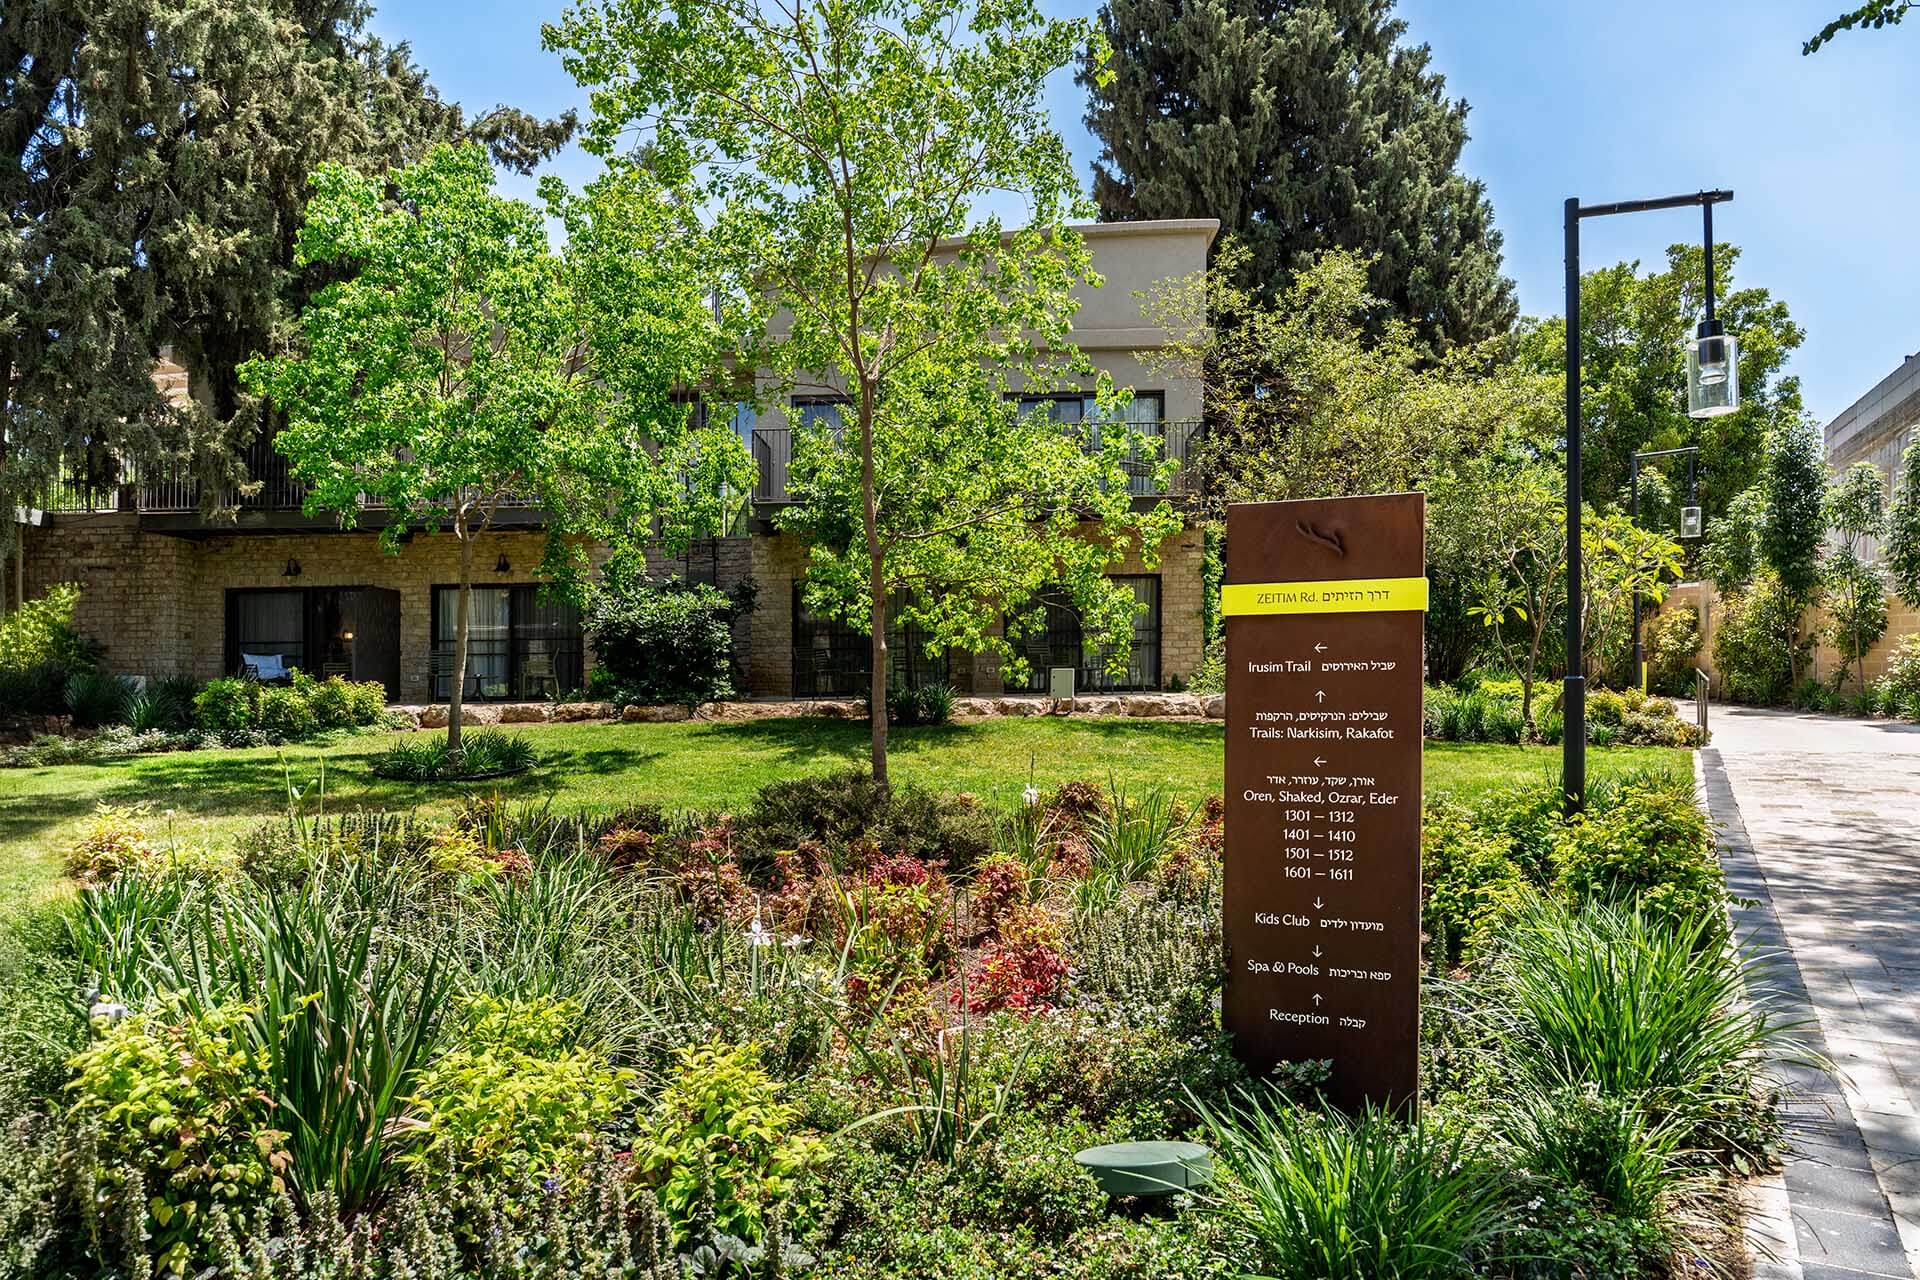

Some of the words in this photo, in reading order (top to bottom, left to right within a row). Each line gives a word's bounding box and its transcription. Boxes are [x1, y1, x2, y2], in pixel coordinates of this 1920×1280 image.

[1257, 593, 1297, 604] ZEITIM
[1300, 592, 1318, 602] Rd.
[1322, 591, 1363, 602] הזיתים
[1366, 590, 1390, 602] דרך
[1248, 661, 1283, 673] Irusim
[1286, 660, 1311, 673] Trail
[1321, 661, 1368, 672] האירוסים
[1370, 659, 1396, 671] שביל
[1255, 711, 1293, 722] הרקפות
[1349, 711, 1389, 721] שבילים:
[1250, 727, 1284, 739] Trails:
[1287, 727, 1343, 740] Narkisim,
[1346, 727, 1394, 739] Rakafot
[1266, 775, 1286, 785] אדר
[1321, 776, 1347, 787] שקד,
[1349, 777, 1375, 787] אורן,
[1243, 790, 1275, 803] Oren,
[1279, 790, 1325, 804] Shaked,
[1328, 792, 1366, 805] Ozrar,
[1369, 792, 1398, 805] Eder
[1285, 809, 1310, 821] 1301
[1329, 810, 1355, 822] 1312
[1283, 828, 1310, 841] 1401
[1328, 830, 1356, 842] 1410
[1285, 847, 1310, 860] 1501
[1328, 850, 1354, 862] 1512
[1285, 866, 1311, 879] 1601
[1329, 868, 1353, 881] 1611
[1255, 912, 1280, 925] Kids
[1282, 914, 1311, 927] Club
[1320, 918, 1348, 929] ילדים
[1350, 920, 1384, 931] מועדון
[1247, 959, 1269, 974] Spa
[1272, 961, 1285, 973] &
[1288, 962, 1319, 976] Pools
[1329, 968, 1367, 980] ובריכות
[1370, 970, 1392, 981] ספא
[1269, 1009, 1330, 1026] Reception
[1339, 1016, 1366, 1029] קבלה
